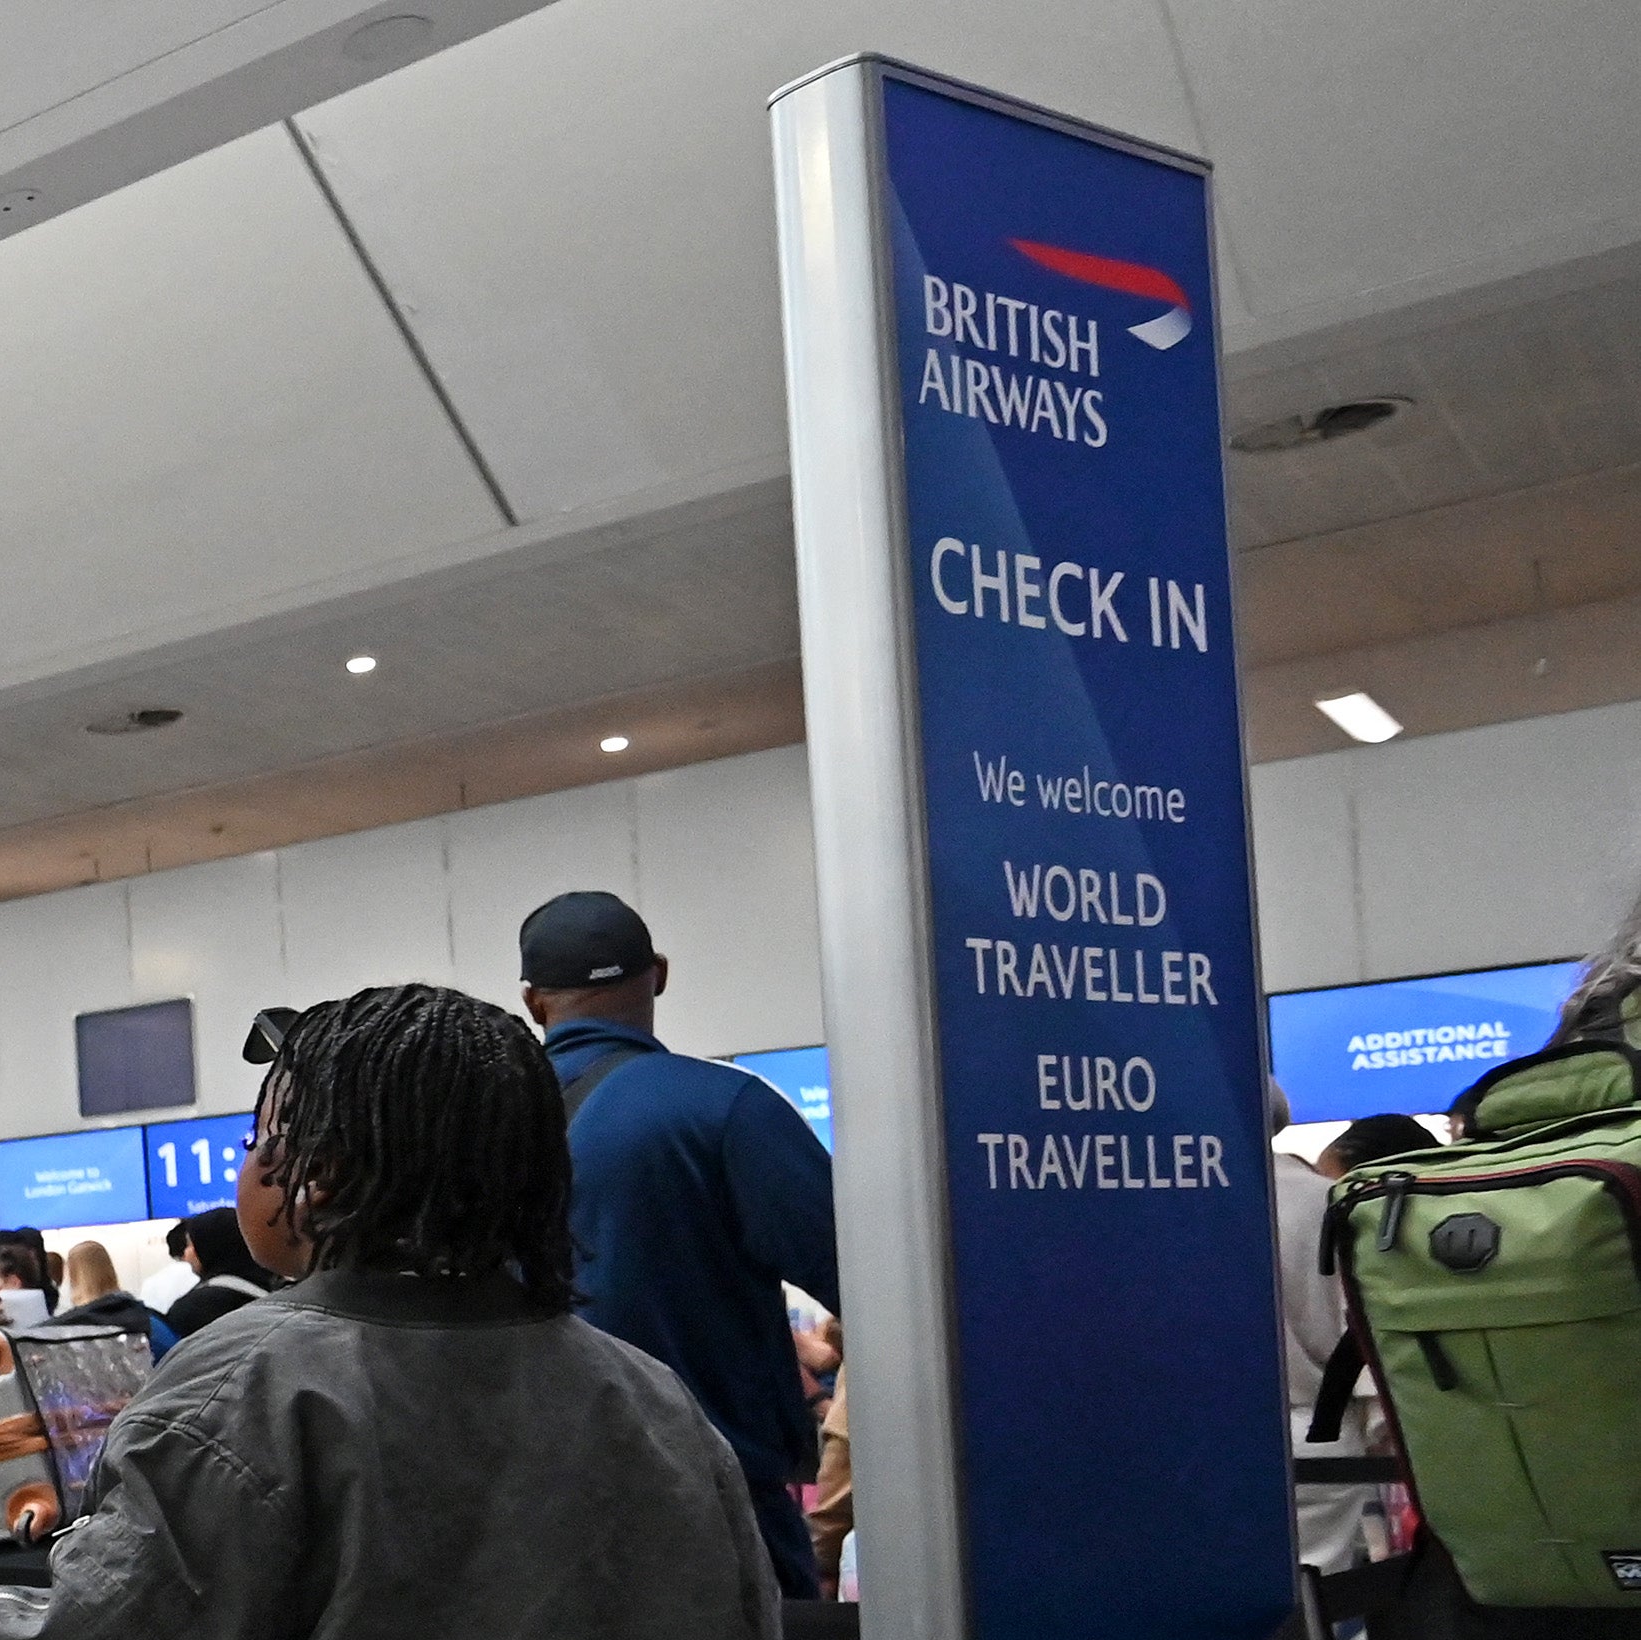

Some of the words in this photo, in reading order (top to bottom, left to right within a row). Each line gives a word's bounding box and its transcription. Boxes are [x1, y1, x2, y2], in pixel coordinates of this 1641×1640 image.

[923, 274, 1100, 378] BRITISH
[918, 348, 1108, 448] AIRWAYS
[930, 536, 1129, 643] CHECK
[1148, 576, 1209, 653] IN
[973, 750, 1026, 806] We
[1035, 764, 1186, 824] welcome
[1002, 860, 1168, 927] WORLD
[965, 937, 1219, 1006] TRAVELLER
[1346, 1020, 1511, 1053] ADDITIONAL
[1351, 1038, 1508, 1072] ASSISTANCE
[1037, 1053, 1157, 1113] EURO
[157, 1137, 238, 1188] 11:
[976, 1132, 1231, 1190] TRAVELLER
